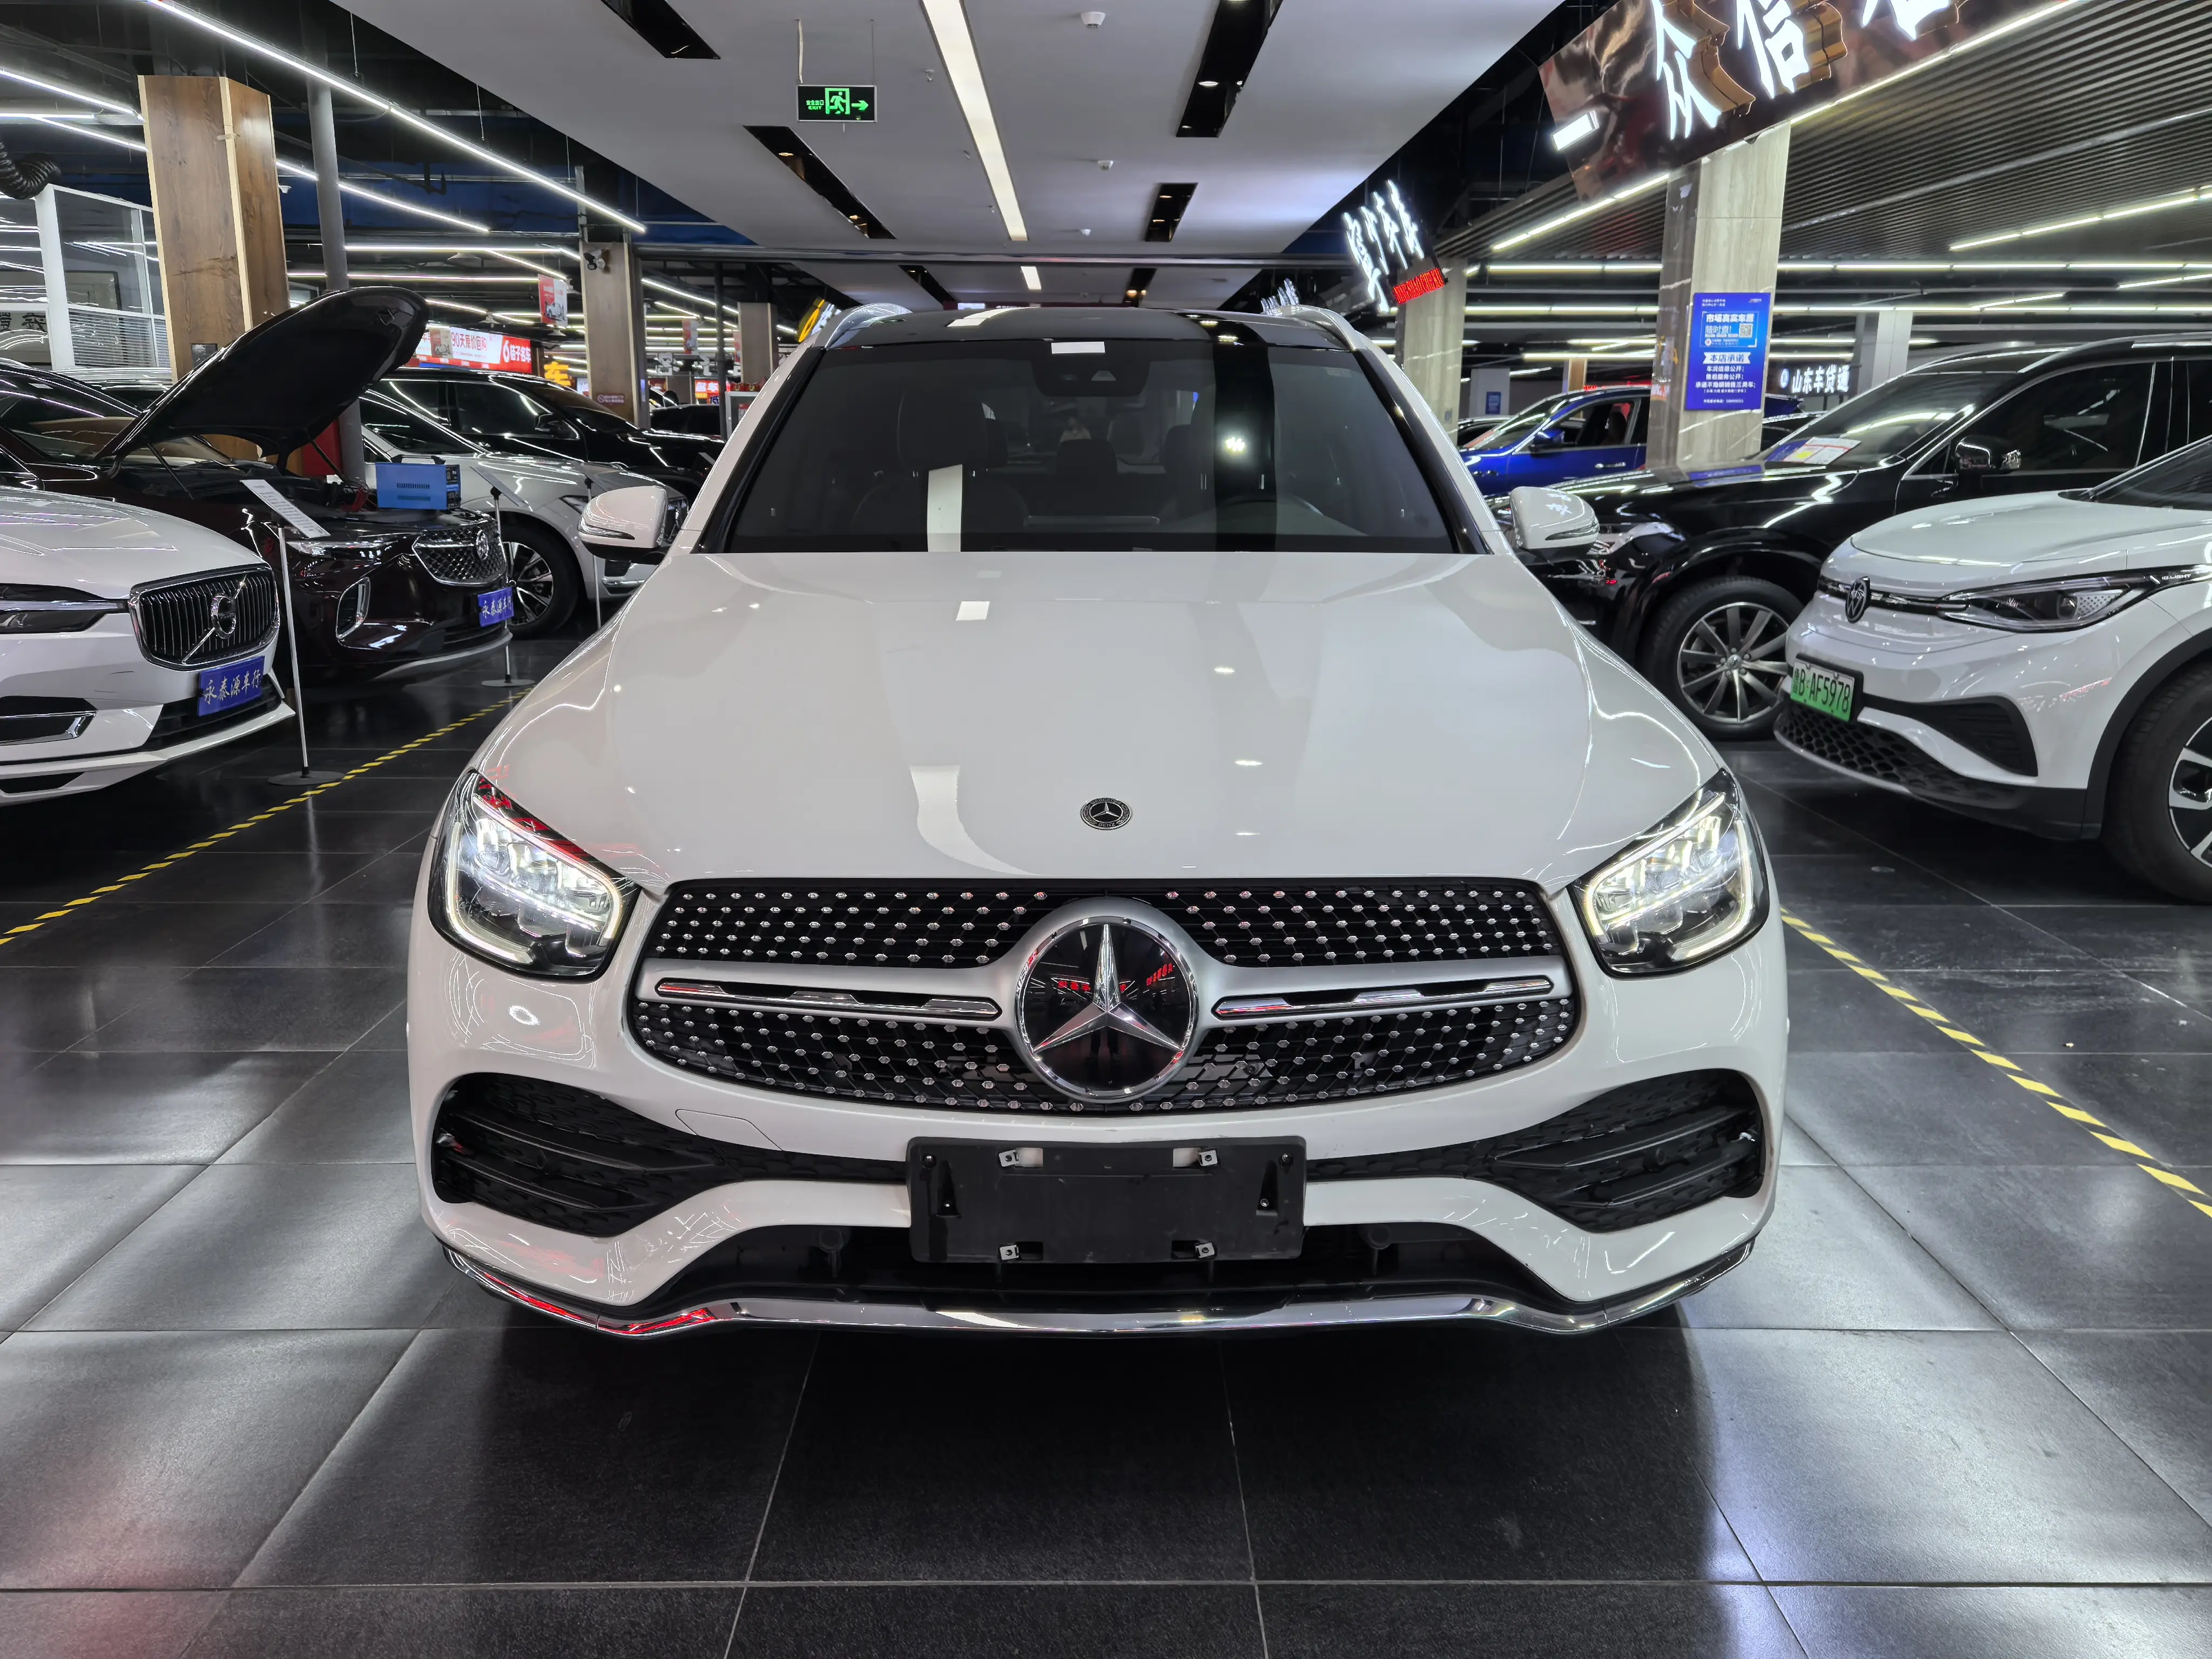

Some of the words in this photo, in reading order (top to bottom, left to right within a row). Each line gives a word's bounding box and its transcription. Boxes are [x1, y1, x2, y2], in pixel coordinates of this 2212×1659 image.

[203, 669, 261, 705] 永泰源车行
